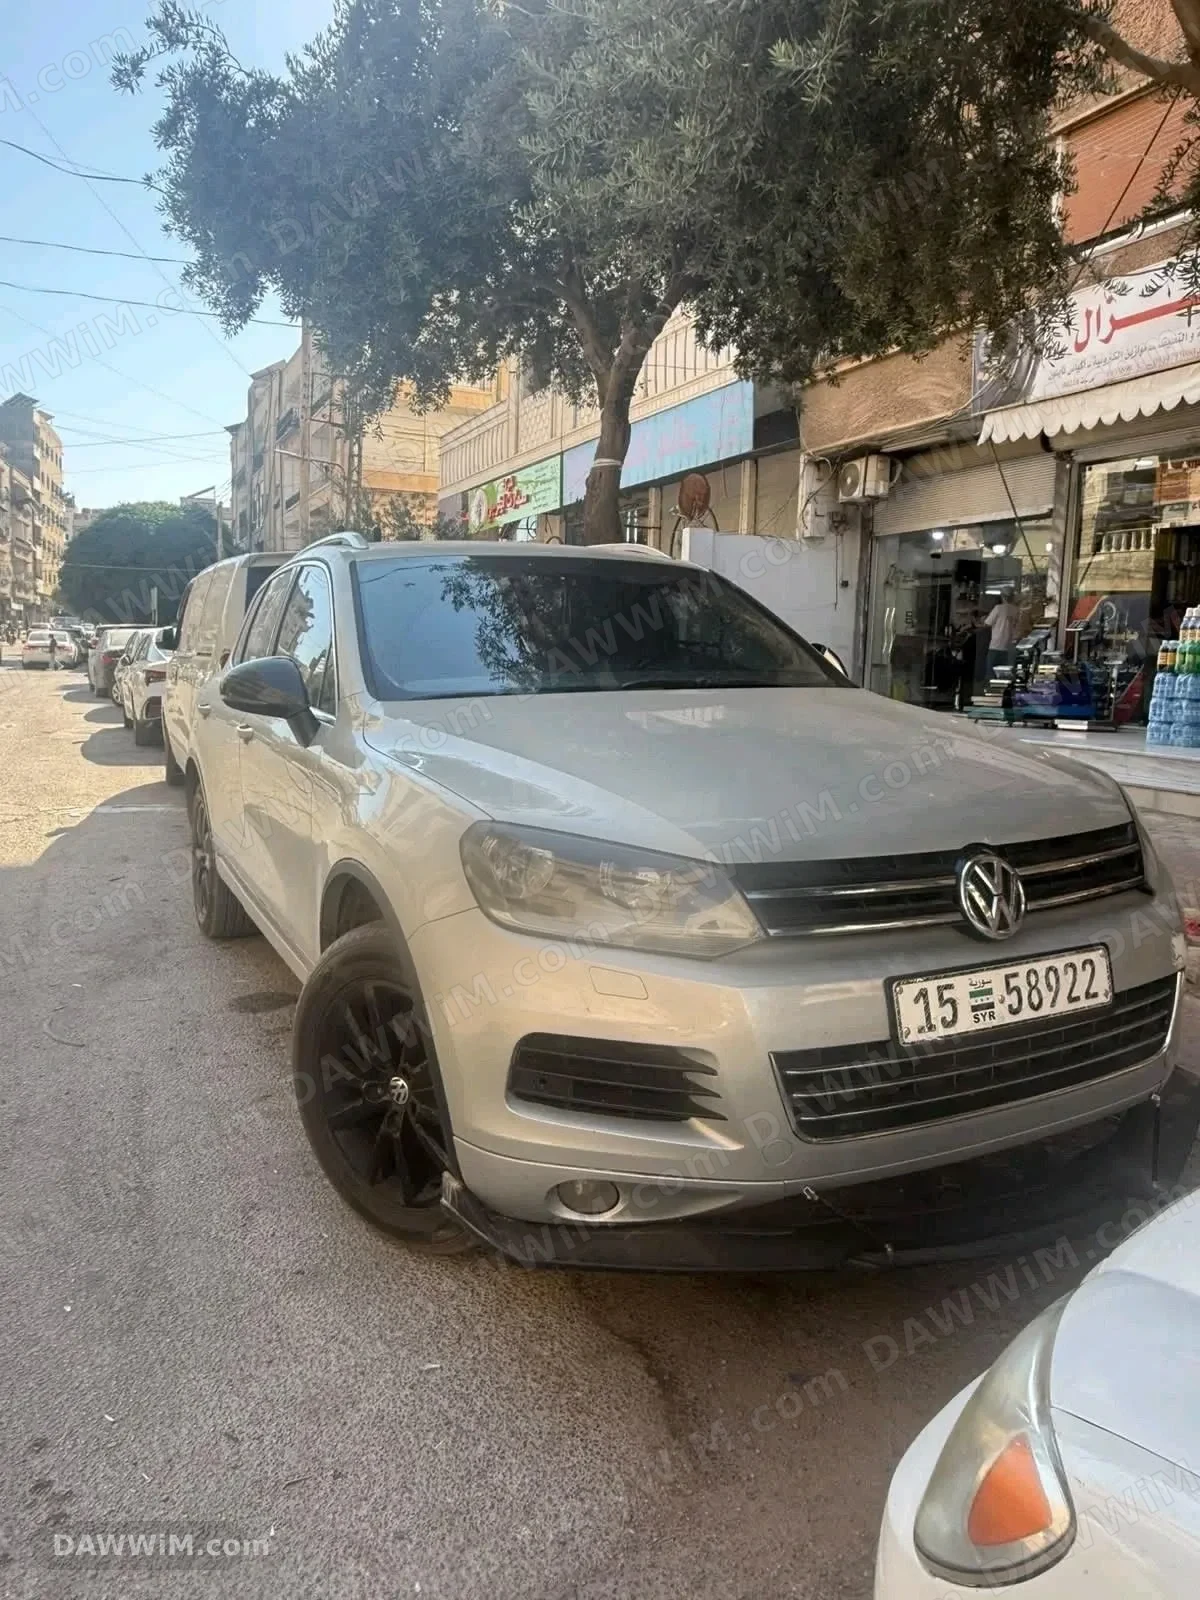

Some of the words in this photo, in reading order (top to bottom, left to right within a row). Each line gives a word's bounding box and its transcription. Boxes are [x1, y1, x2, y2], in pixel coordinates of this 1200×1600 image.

[913, 984, 959, 1034] 15
[1003, 958, 1099, 1016] 58922
[973, 1010, 996, 1024] SYR
